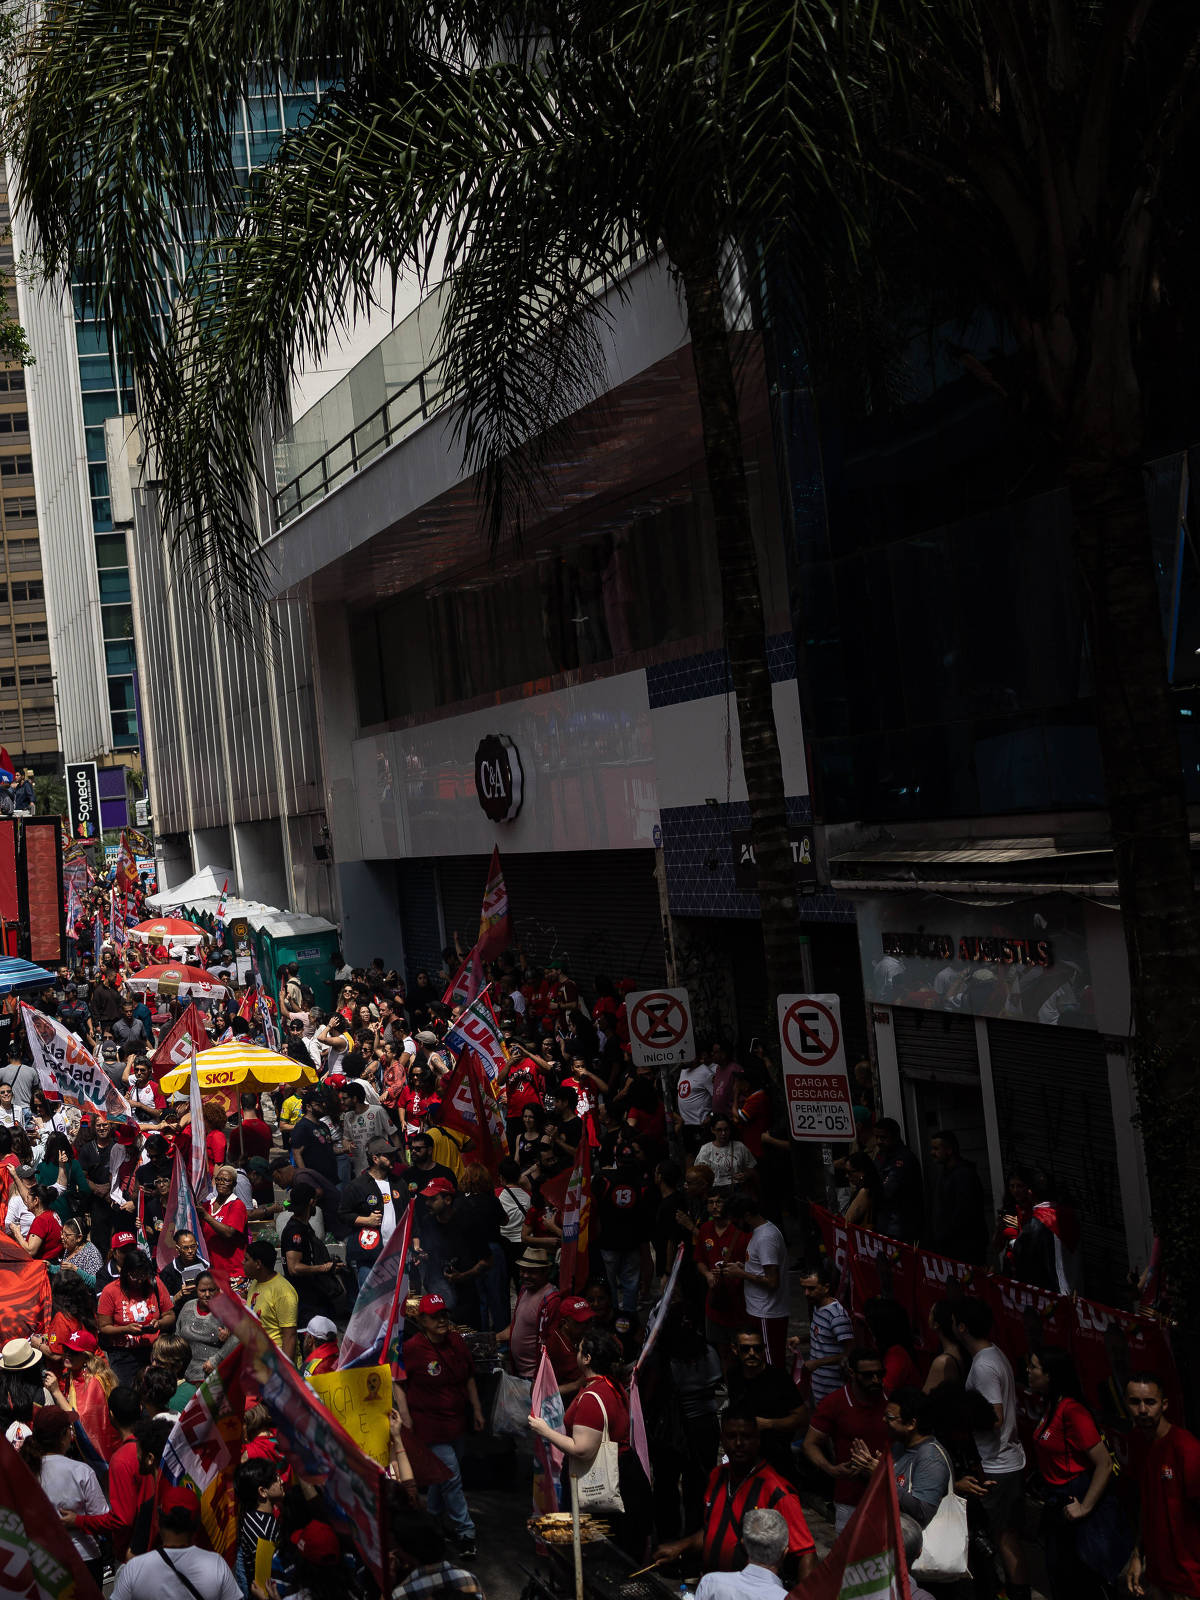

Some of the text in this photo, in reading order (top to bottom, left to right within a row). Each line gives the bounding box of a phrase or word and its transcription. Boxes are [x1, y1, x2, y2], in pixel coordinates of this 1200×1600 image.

[481, 759, 506, 799] C&A
[77, 771, 90, 821] Soneda
[643, 1052, 674, 1062] INÍCIO
[205, 1071, 236, 1085] SKOL
[794, 1078, 839, 1087] CARGA E
[791, 1090, 845, 1099] DESCARGA
[795, 1104, 844, 1114] PERMITIDA
[615, 1189, 632, 1205] 13
[130, 1300, 149, 1322] 13
